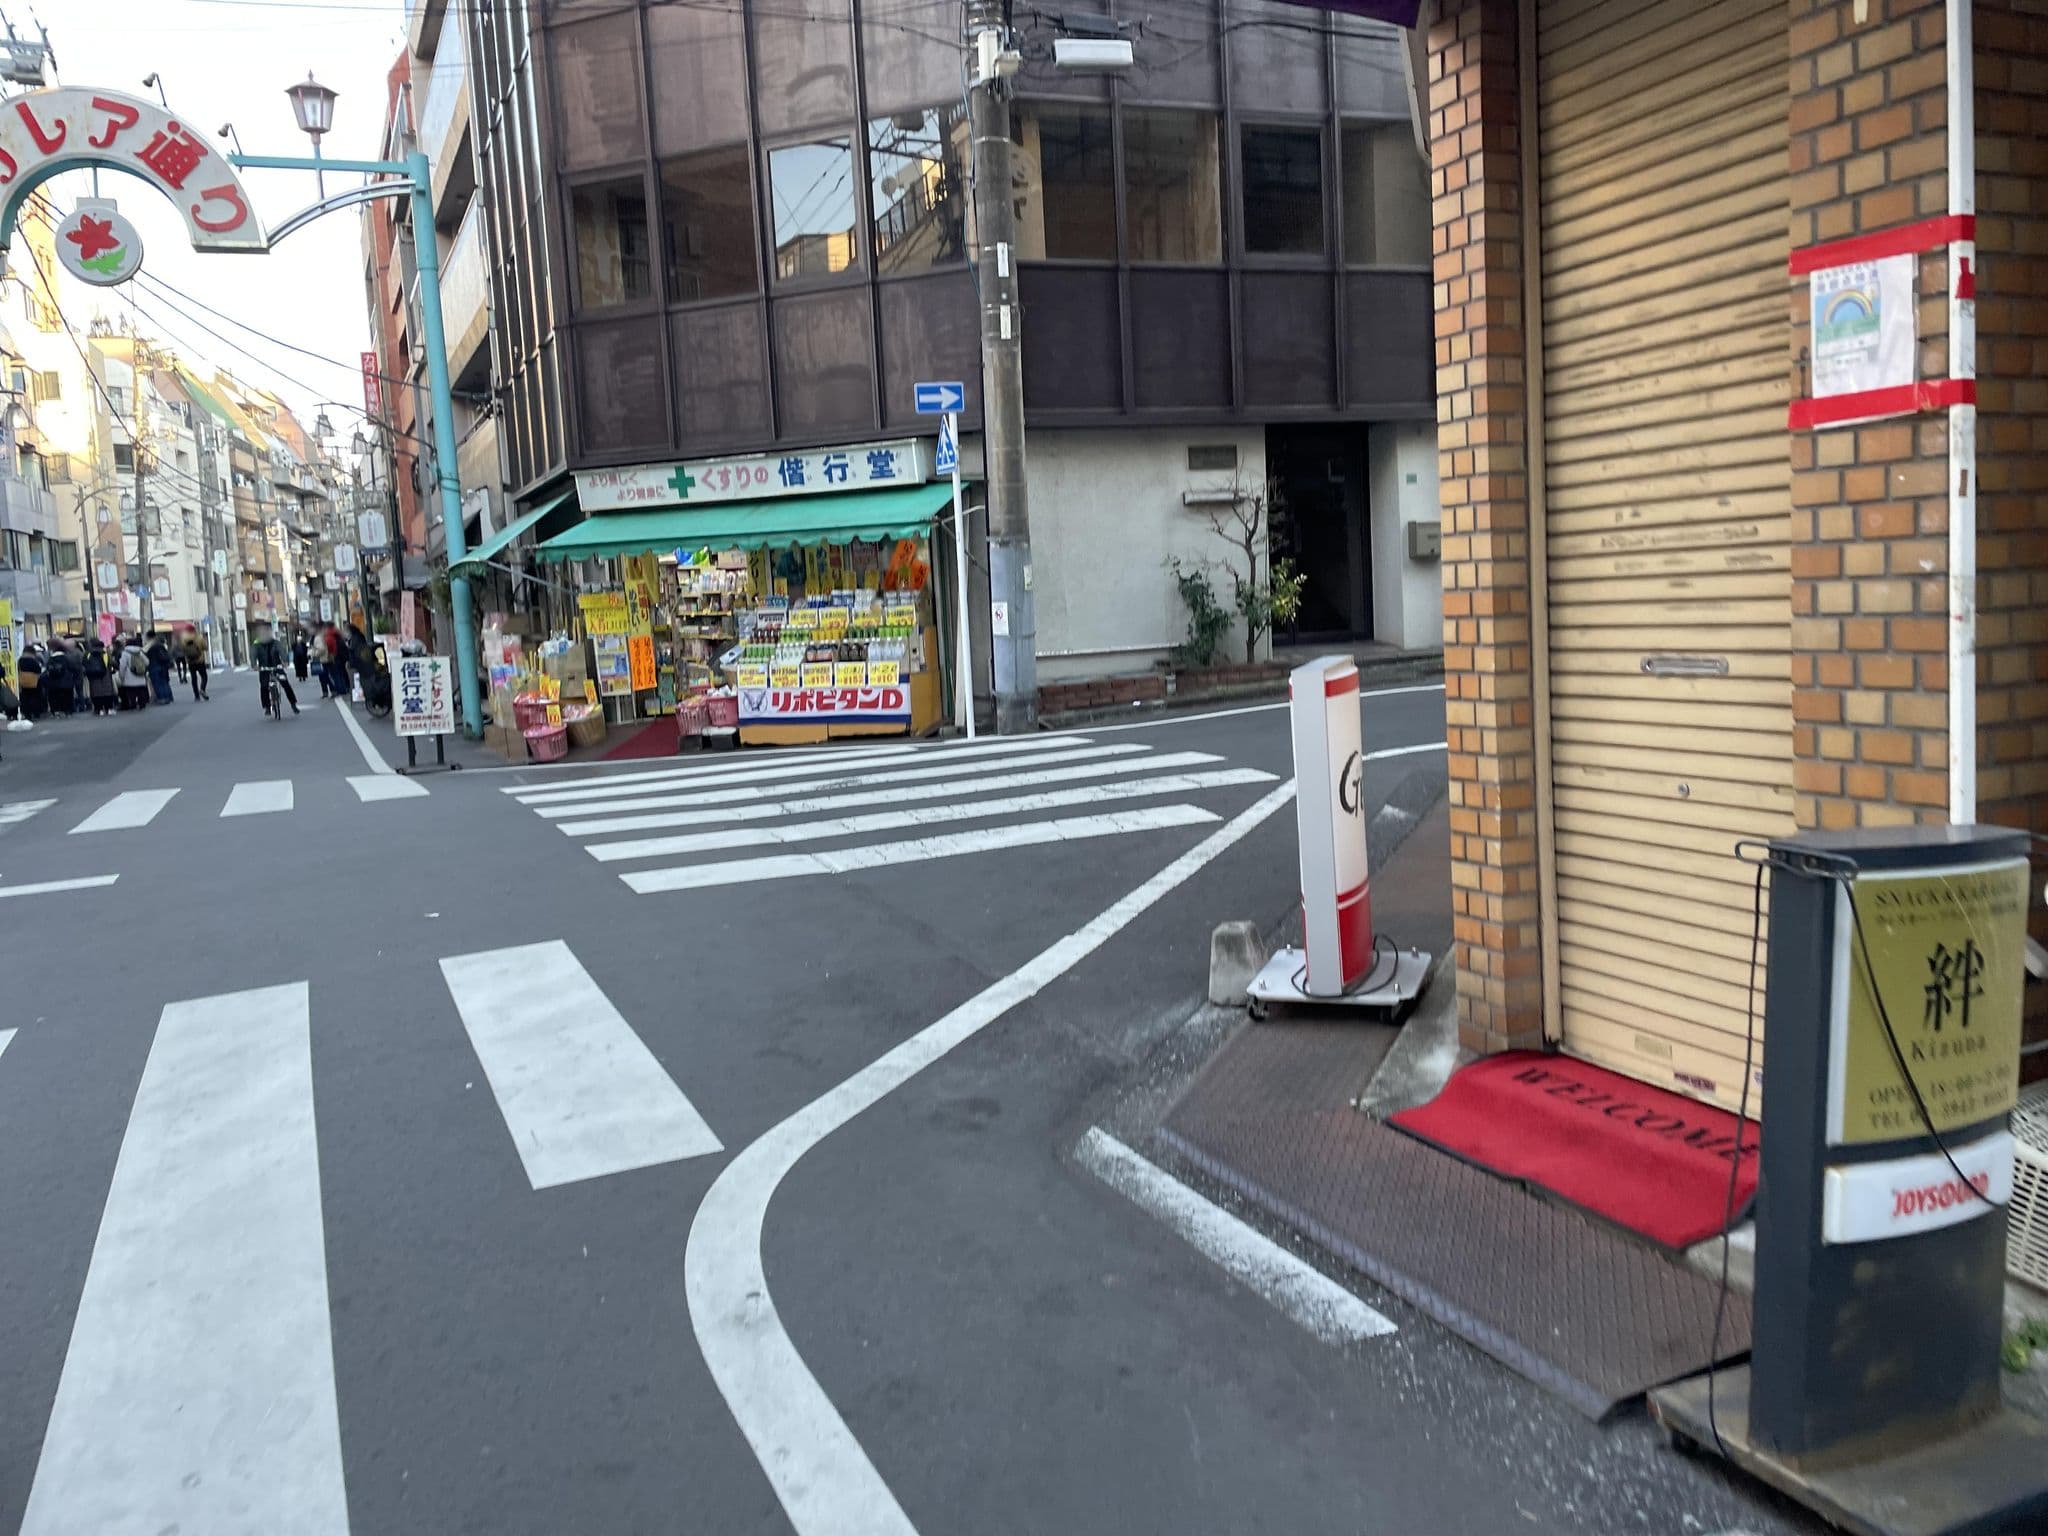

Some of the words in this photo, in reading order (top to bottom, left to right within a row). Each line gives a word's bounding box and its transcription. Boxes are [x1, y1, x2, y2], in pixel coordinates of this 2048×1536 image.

[0, 97, 248, 233] レア通り
[771, 688, 904, 713] リポビタンD
[1922, 938, 1985, 1032] 絆
